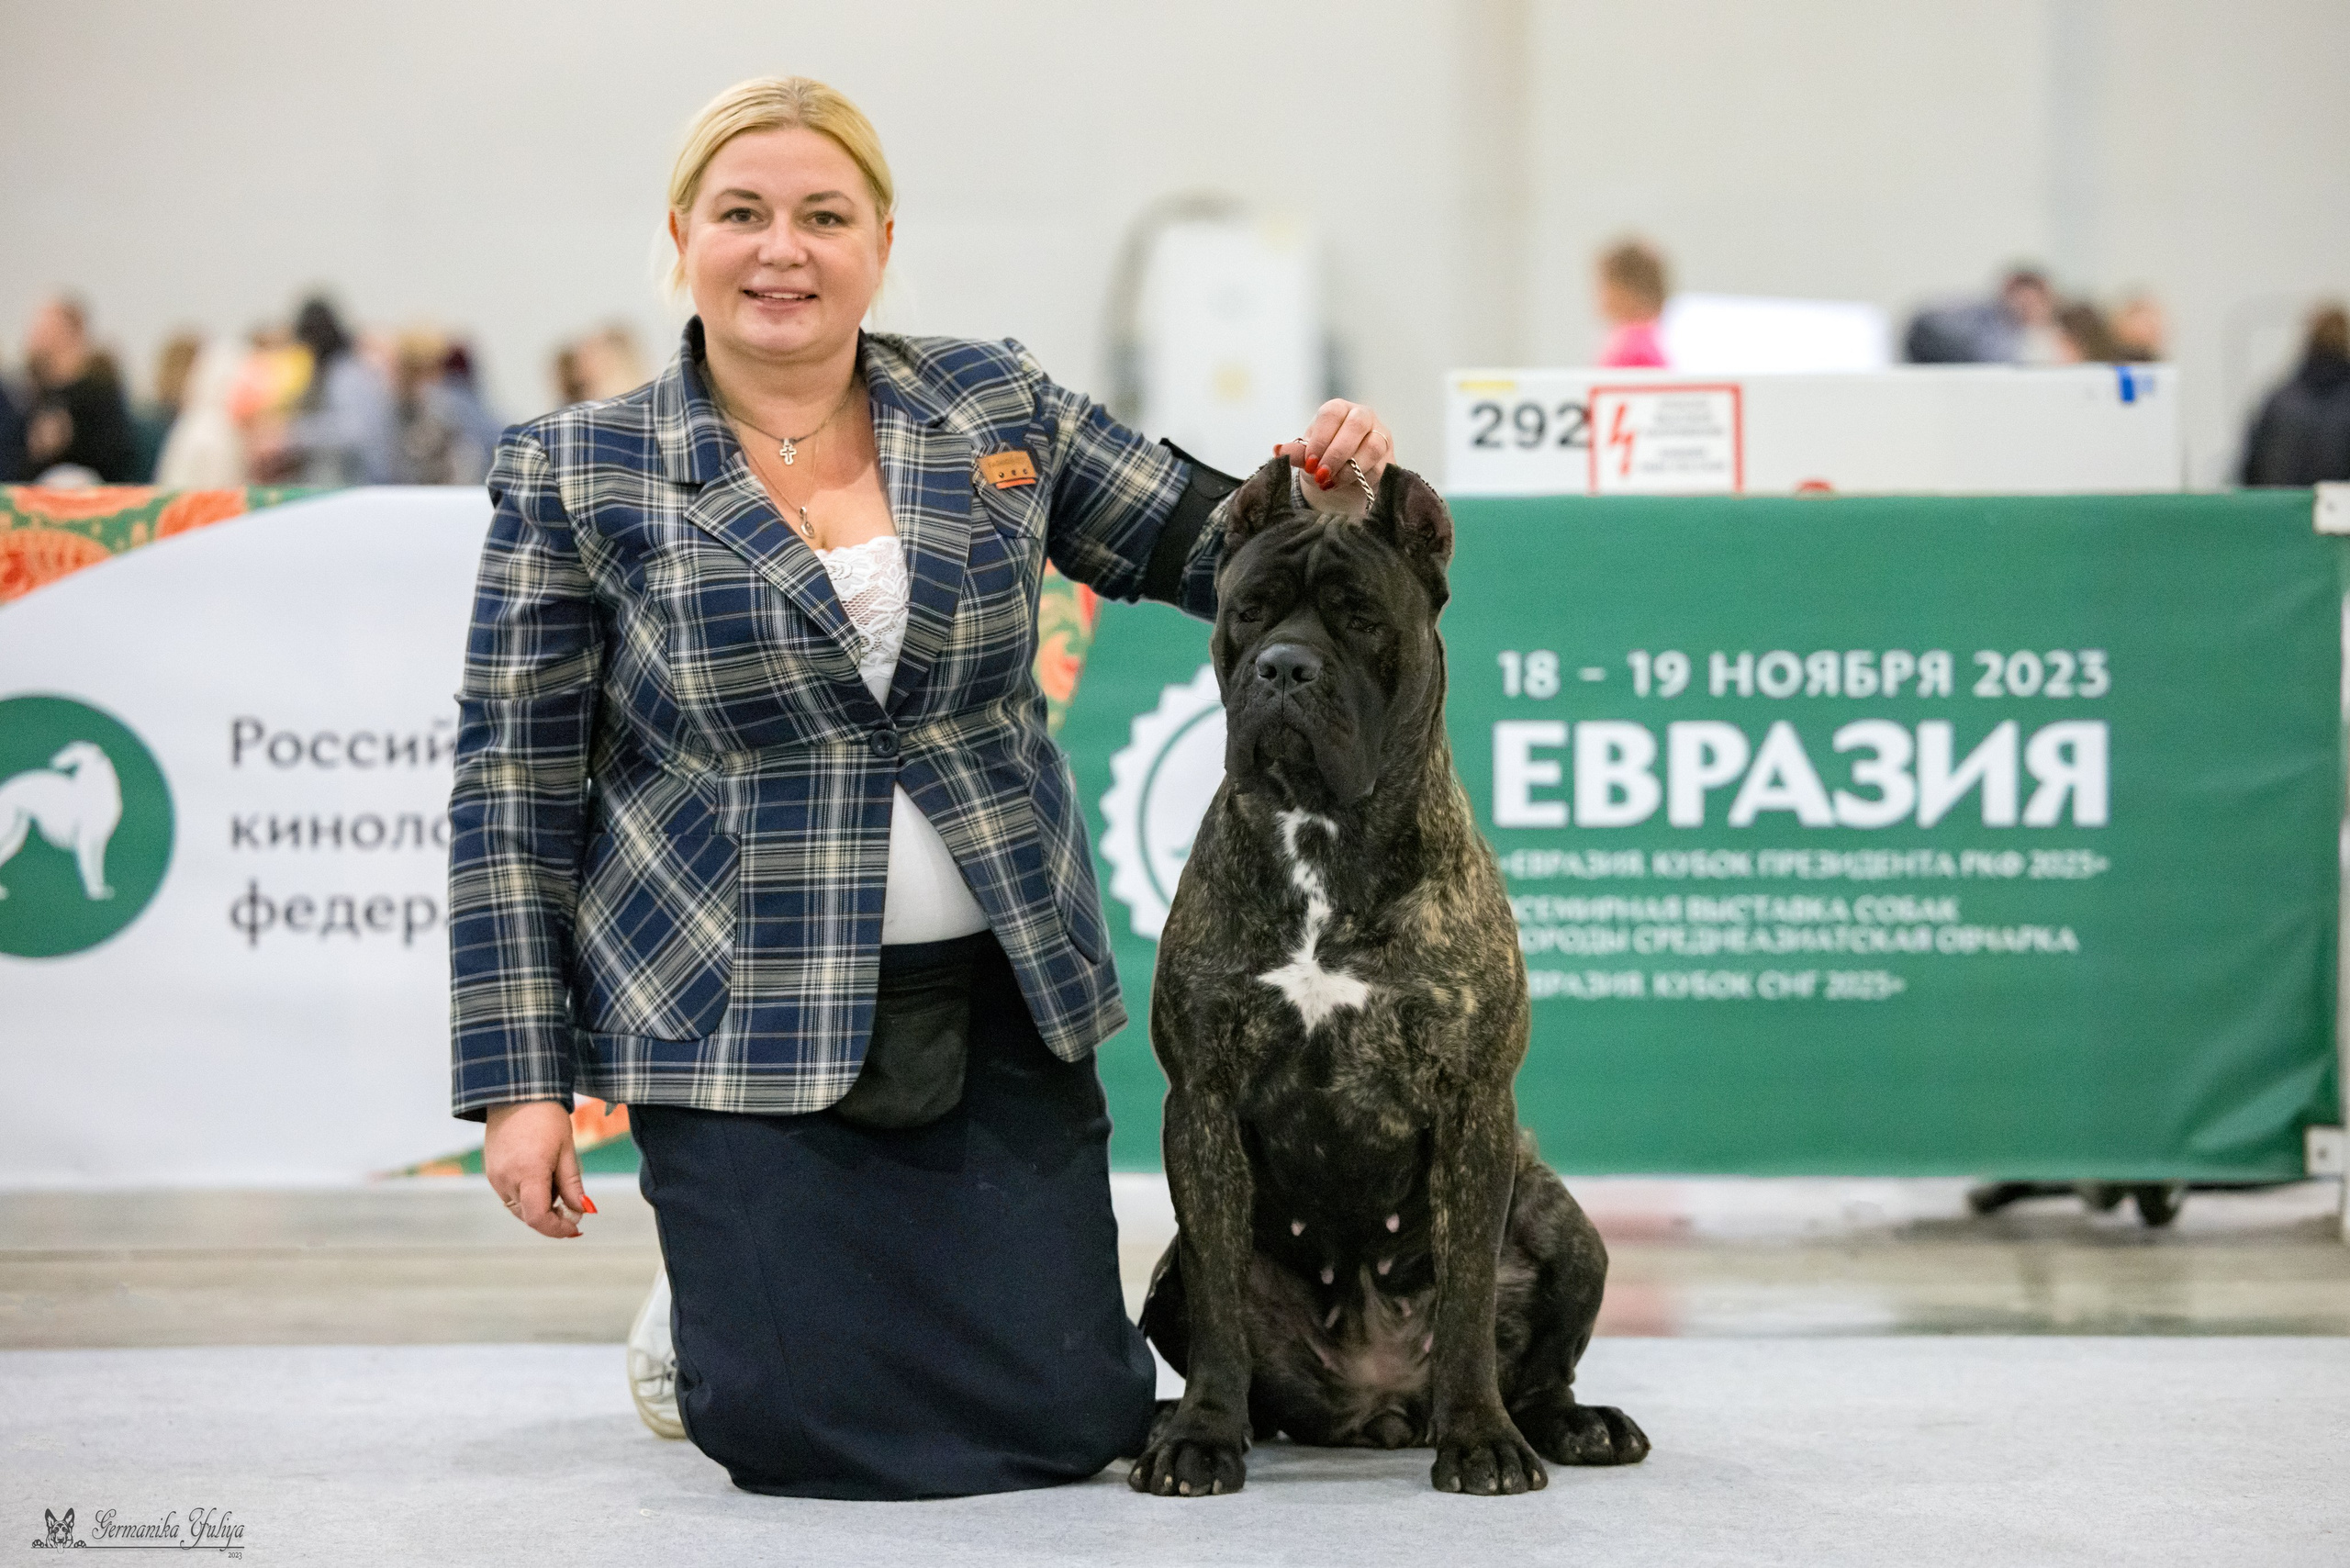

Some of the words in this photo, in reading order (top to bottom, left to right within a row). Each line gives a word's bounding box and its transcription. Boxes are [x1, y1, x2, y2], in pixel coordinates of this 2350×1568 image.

[1470, 399, 1594, 450] 292
[1498, 649, 1561, 700] 18
[1627, 649, 1692, 700] 19
[1707, 649, 1954, 700] НОЯБРЯ
[1971, 649, 2111, 700] 2023
[1491, 718, 2111, 829] ЕВРАЗИЯ
[1653, 849, 1751, 879] КУБОК
[1757, 849, 1958, 879] ПРЕЗИДЕНТА
[229, 878, 449, 947] федер
[1685, 895, 1851, 924] ВЫСТАВКА
[1853, 895, 1960, 924] СОБАК
[1935, 925, 2081, 954] ОВЧАРКА
[1653, 970, 1751, 999] КУБОК
[1756, 970, 1818, 1000] СНГ
